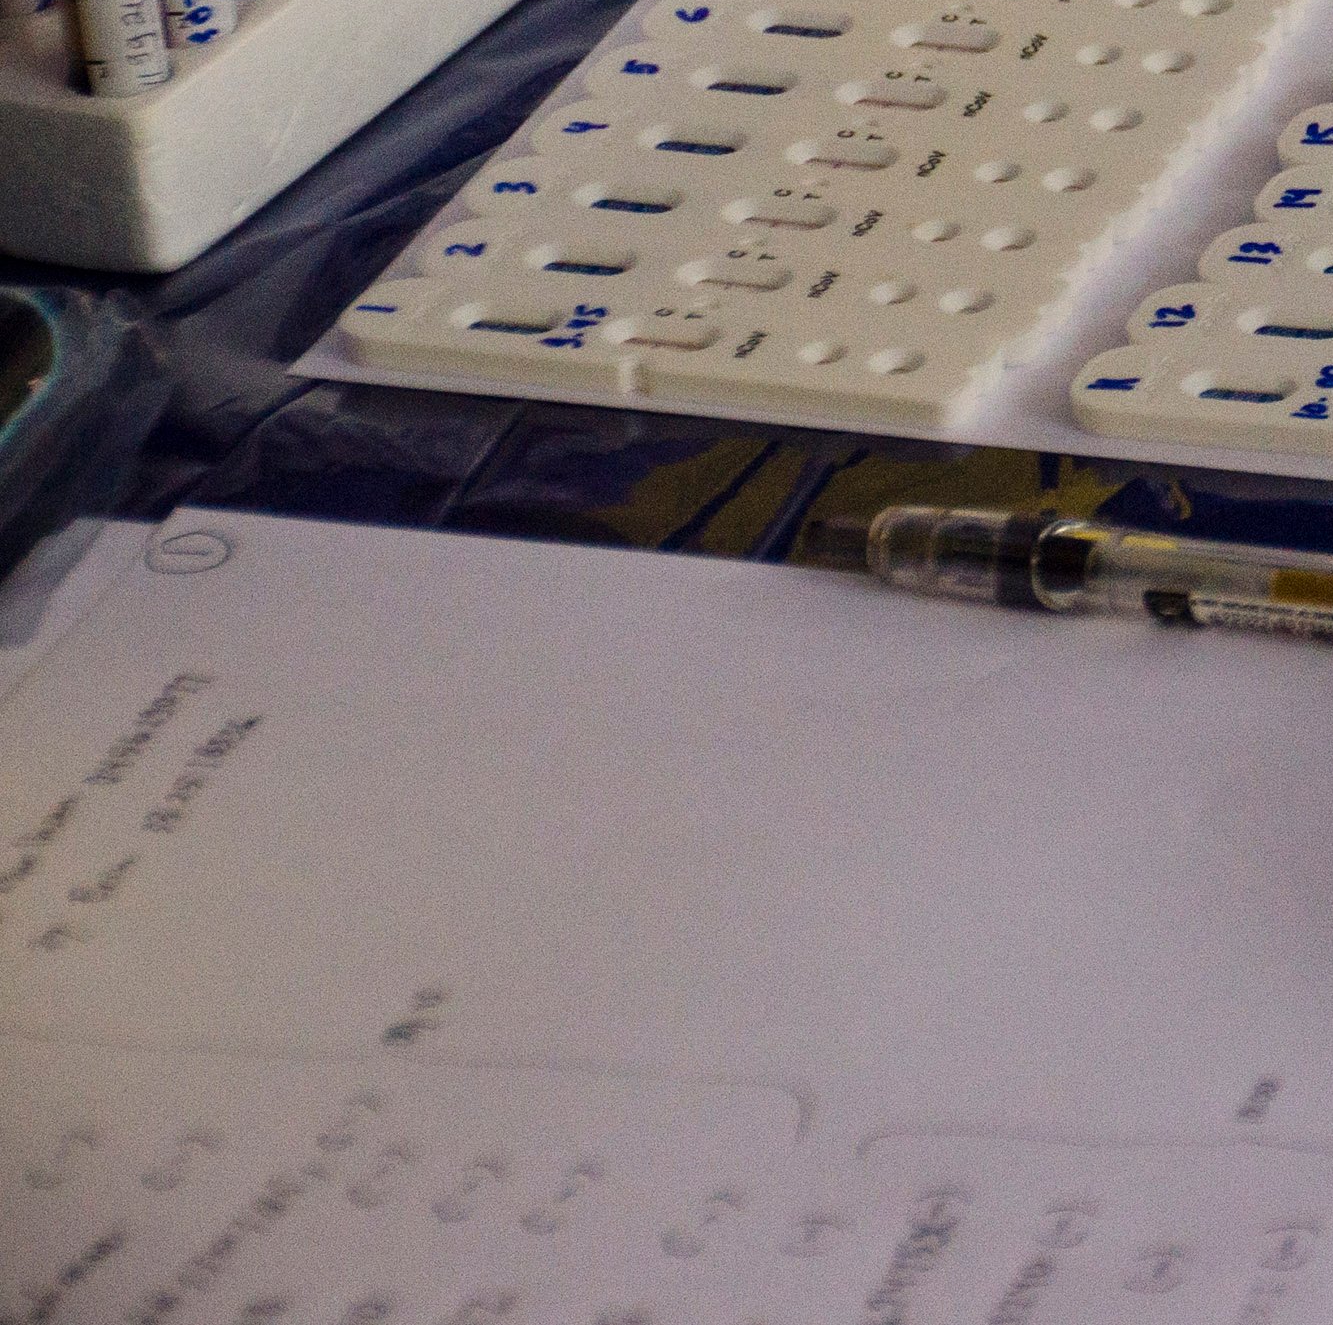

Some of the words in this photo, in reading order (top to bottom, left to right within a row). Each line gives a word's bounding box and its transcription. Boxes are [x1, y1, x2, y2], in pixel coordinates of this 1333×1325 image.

[676, 8, 709, 22] 6
[494, 182, 536, 194] 3
[1275, 189, 1320, 208] 14
[445, 243, 485, 256] 2
[1229, 242, 1281, 264] 13
[357, 305, 396, 313] 1
[1150, 305, 1195, 327] 12
